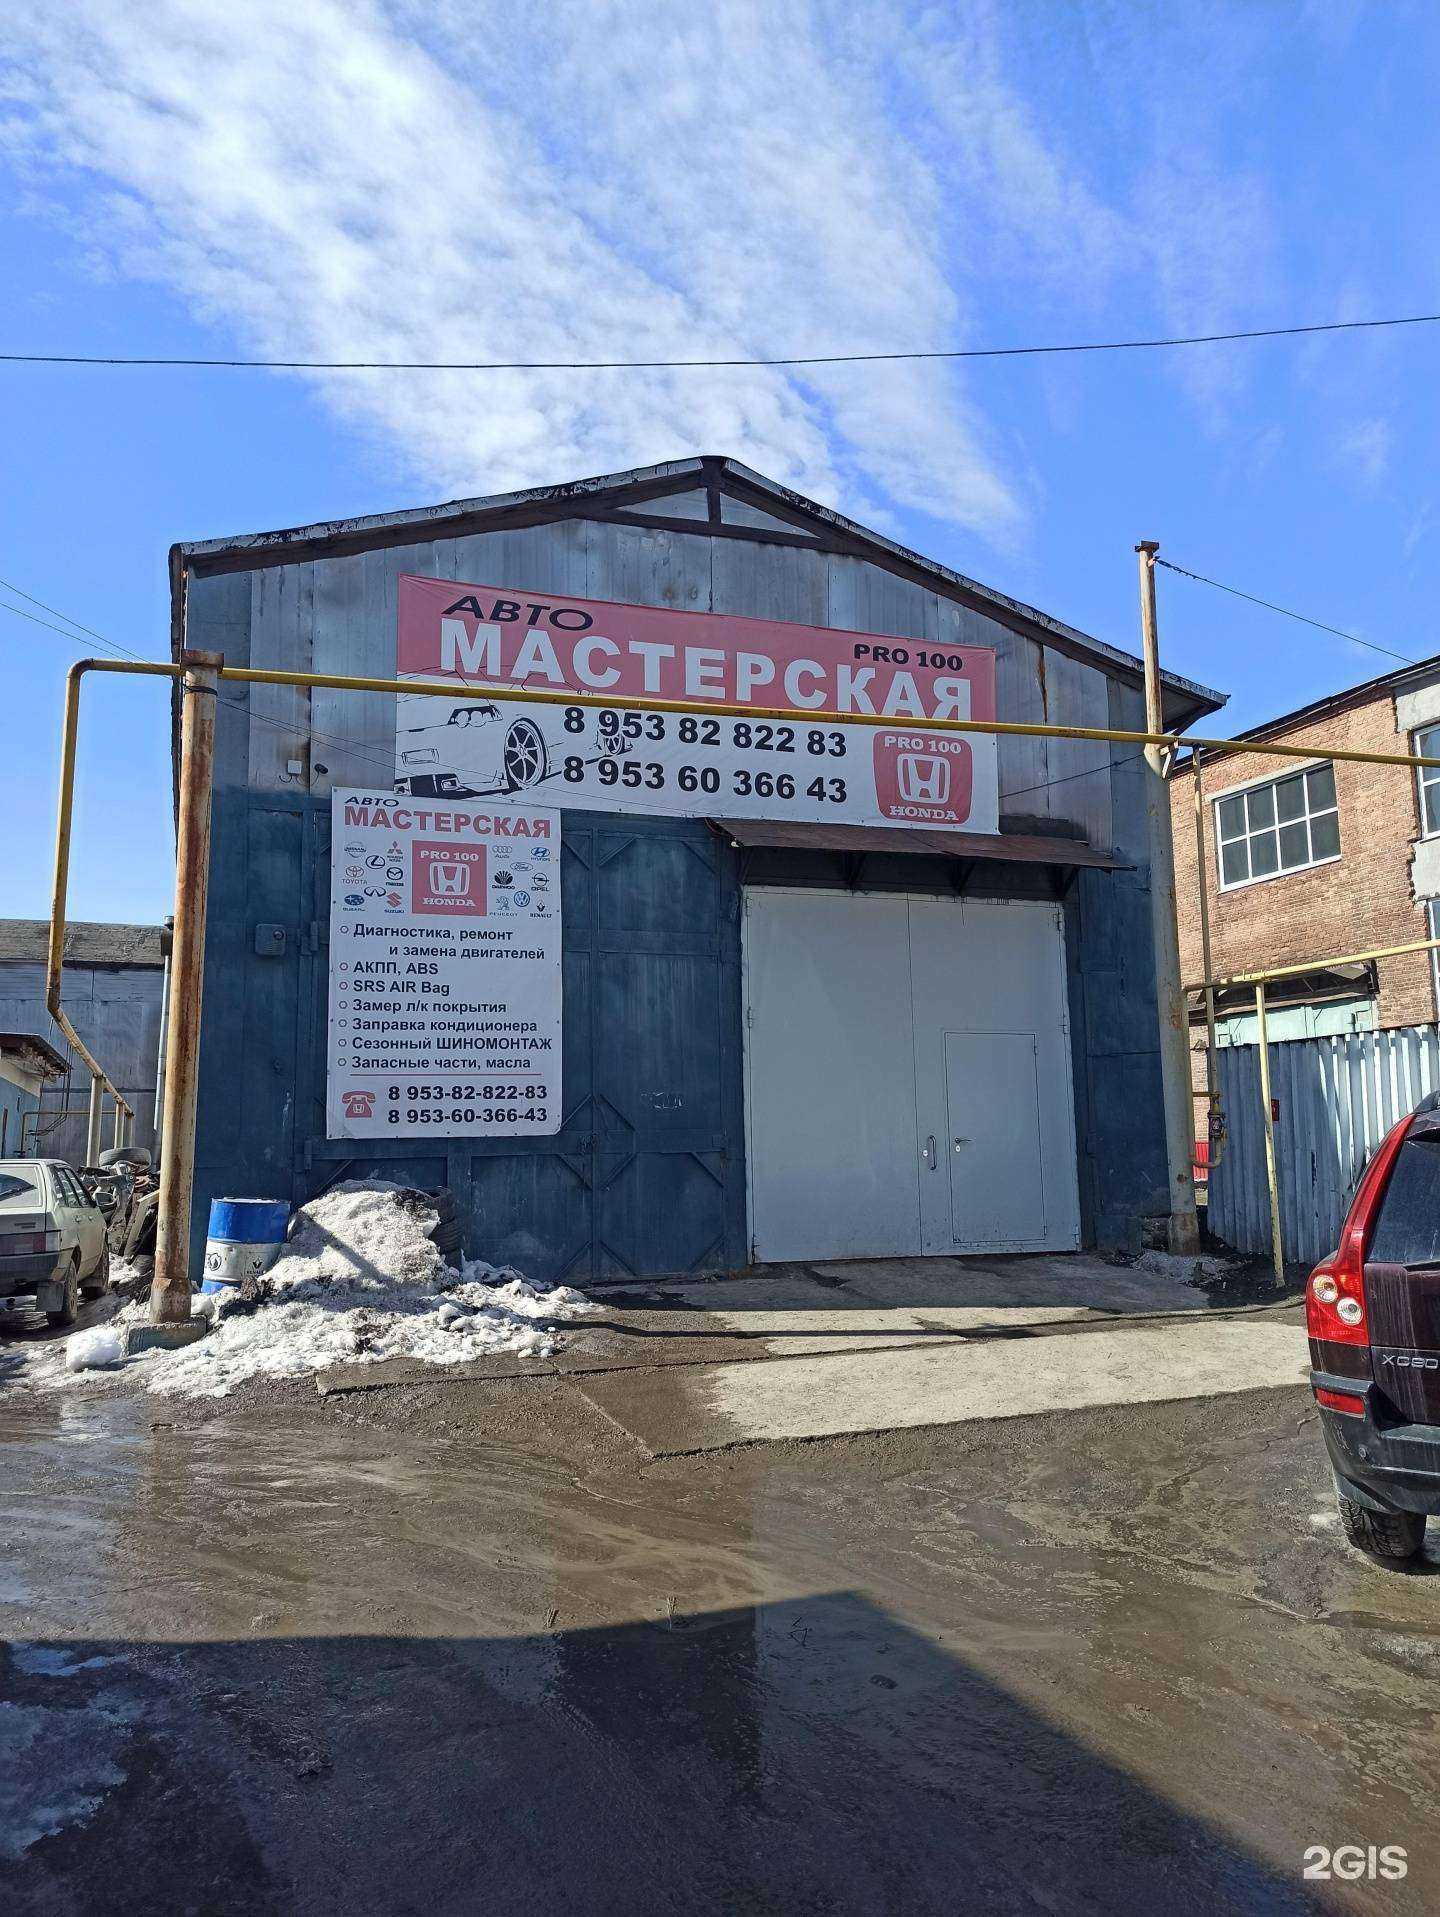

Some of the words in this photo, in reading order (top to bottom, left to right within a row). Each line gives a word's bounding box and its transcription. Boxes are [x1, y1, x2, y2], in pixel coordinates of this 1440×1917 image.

[441, 595, 594, 631] АВТО
[853, 643, 909, 665] PRO
[916, 651, 963, 672] 100
[440, 617, 972, 722] МАСТЕРСКАЯ
[563, 706, 585, 734] 8
[597, 709, 666, 741] 953
[678, 716, 721, 746] 82
[733, 722, 796, 753] 822
[806, 729, 847, 758] 83
[884, 735, 924, 750] PRO
[927, 739, 962, 754] 100
[563, 755, 585, 783] 8
[597, 758, 666, 790] 953
[677, 765, 721, 794] 60
[733, 769, 796, 800] 366
[806, 776, 848, 804] 43
[344, 796, 400, 807] АВТО
[889, 805, 960, 821] HONDA
[344, 805, 551, 839] МАСТЕРСКАЯ
[420, 850, 450, 861] PRO
[453, 851, 479, 862] 100
[422, 897, 476, 907] HONDA
[353, 923, 455, 940] Диагностика,
[459, 929, 513, 941] ремонт
[389, 946, 398, 955] и
[403, 946, 457, 957] замена
[460, 947, 545, 960] двигателей
[353, 961, 401, 976] АКПП,
[406, 962, 439, 975] ABS
[353, 980, 385, 992] SRS
[389, 980, 416, 993] AIR
[421, 981, 450, 996] Bag
[353, 999, 401, 1014] Замер
[406, 1000, 429, 1012] л/к
[433, 1002, 507, 1014] покрытия
[352, 1018, 426, 1032] Заправка
[430, 1020, 538, 1033] кондиционера
[352, 1036, 432, 1050] Сезонный
[436, 1037, 552, 1050] ШИНОМОНТАЖ
[351, 1056, 430, 1068] Запасные
[434, 1057, 481, 1070] части,
[486, 1058, 531, 1069] масла
[388, 1086, 400, 1100] 8
[407, 1085, 548, 1101] 953-82-822-83
[388, 1109, 400, 1123] 8
[406, 1107, 548, 1123] 953-60-366-43
[1382, 1354, 1439, 1370] XC90
